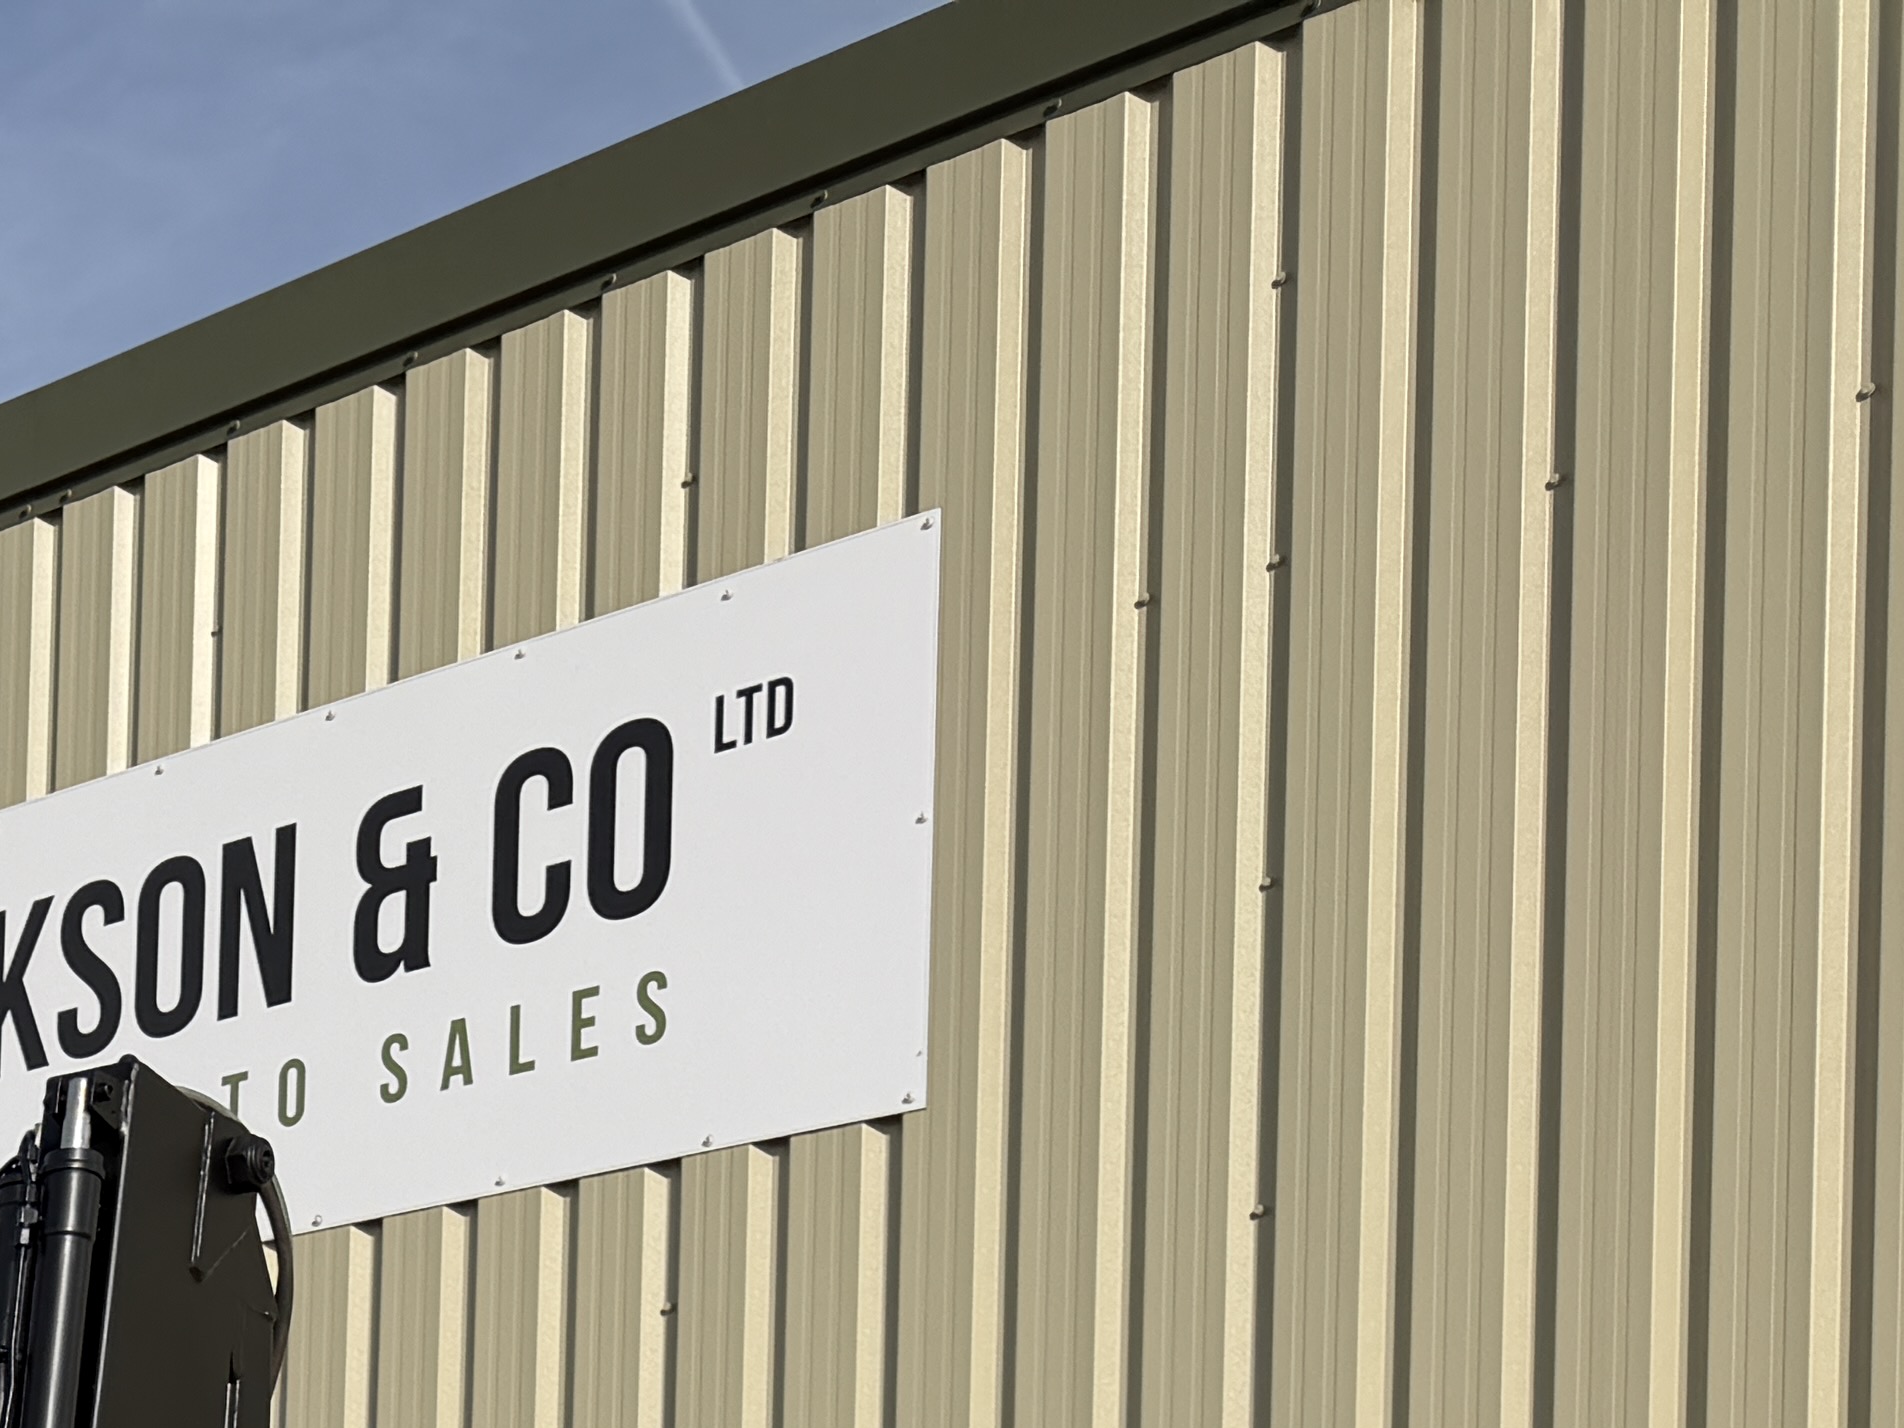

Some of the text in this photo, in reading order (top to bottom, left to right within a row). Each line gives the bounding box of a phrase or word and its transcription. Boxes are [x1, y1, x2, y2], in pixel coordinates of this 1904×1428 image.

[352, 784, 438, 984] &
[491, 717, 675, 946] CO
[713, 676, 794, 754] LTD
[221, 1058, 307, 1128] TO
[379, 970, 668, 1104] SALES
